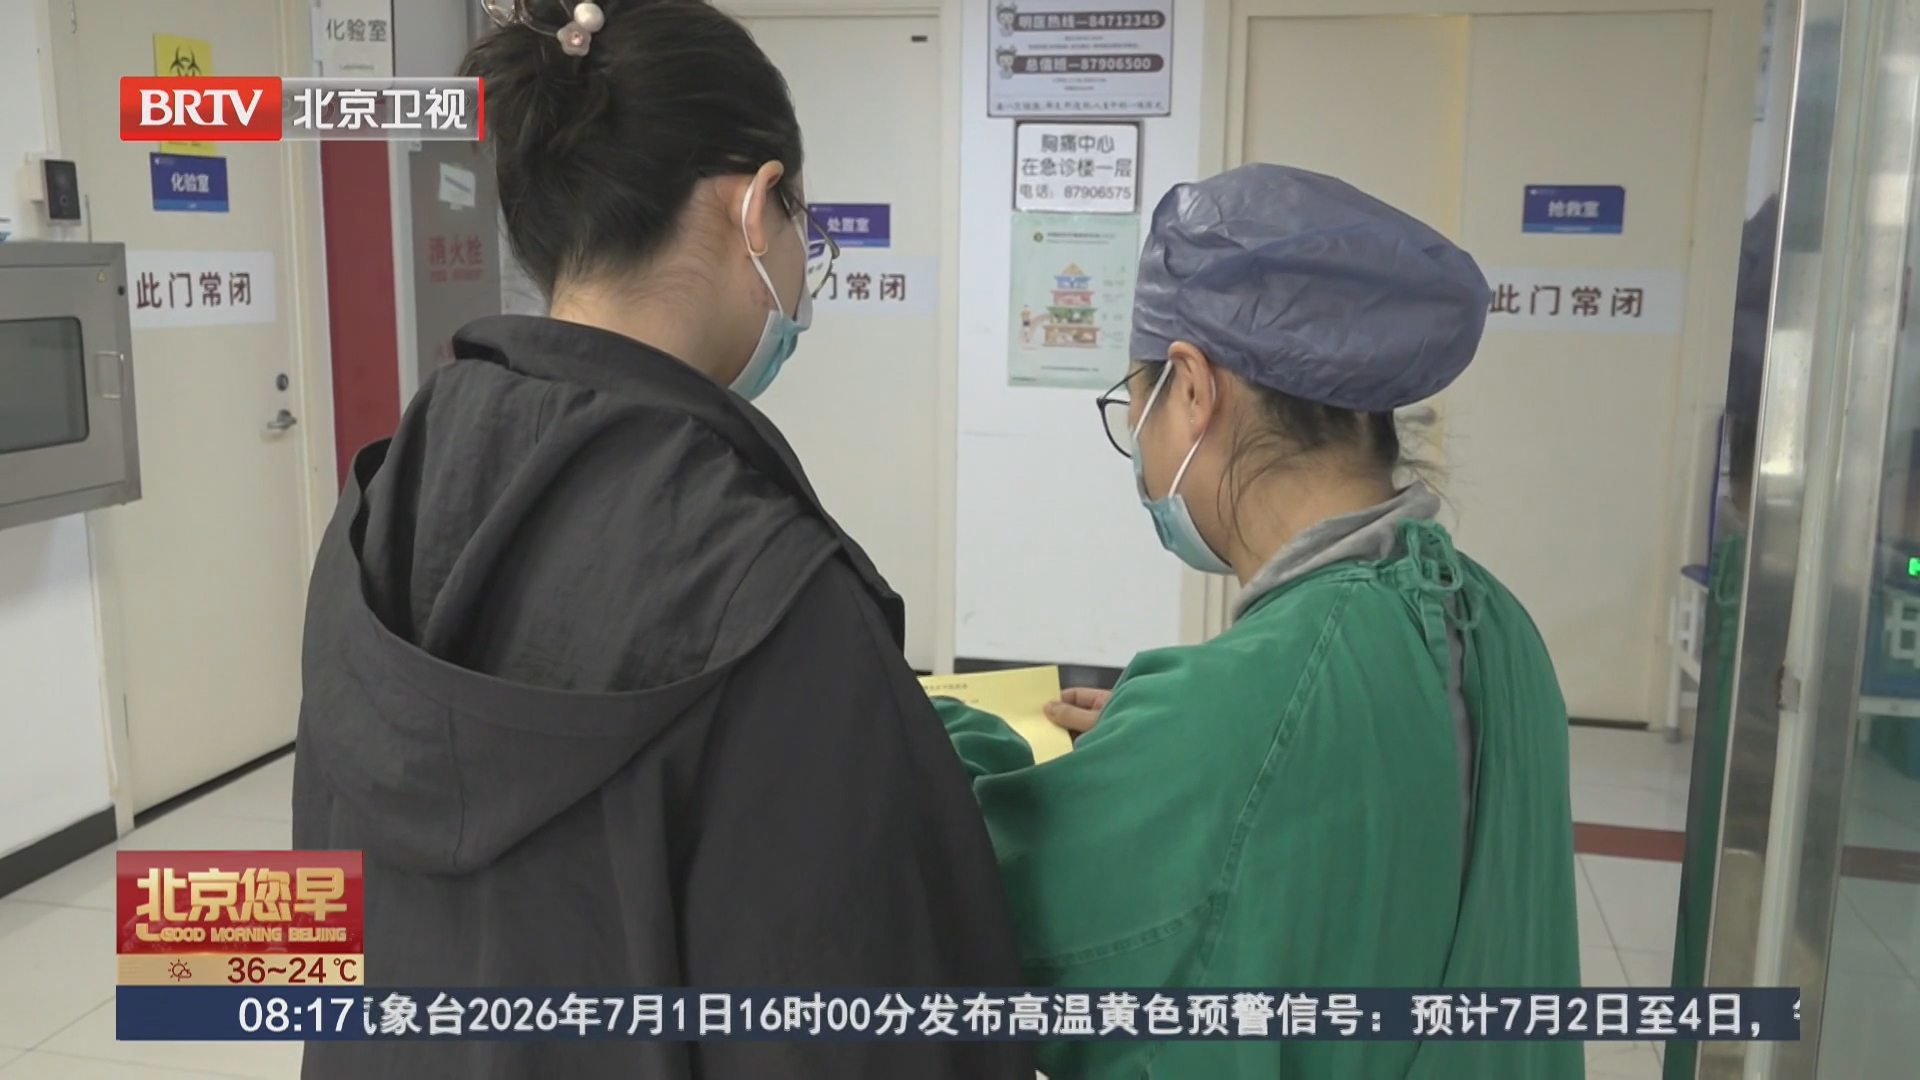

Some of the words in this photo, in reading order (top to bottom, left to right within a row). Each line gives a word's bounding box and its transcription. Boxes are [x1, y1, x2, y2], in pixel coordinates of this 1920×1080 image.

[326, 18, 387, 42] 化验室
[1041, 133, 1114, 154] 胸痛中心
[1022, 157, 1132, 177] 在急诊楼一层
[171, 172, 210, 193] 化验室
[1548, 201, 1600, 217] 抢救室
[827, 217, 870, 233] 处置室
[136, 272, 252, 309] 此门常闭
[1489, 284, 1644, 318] 此门常闭
